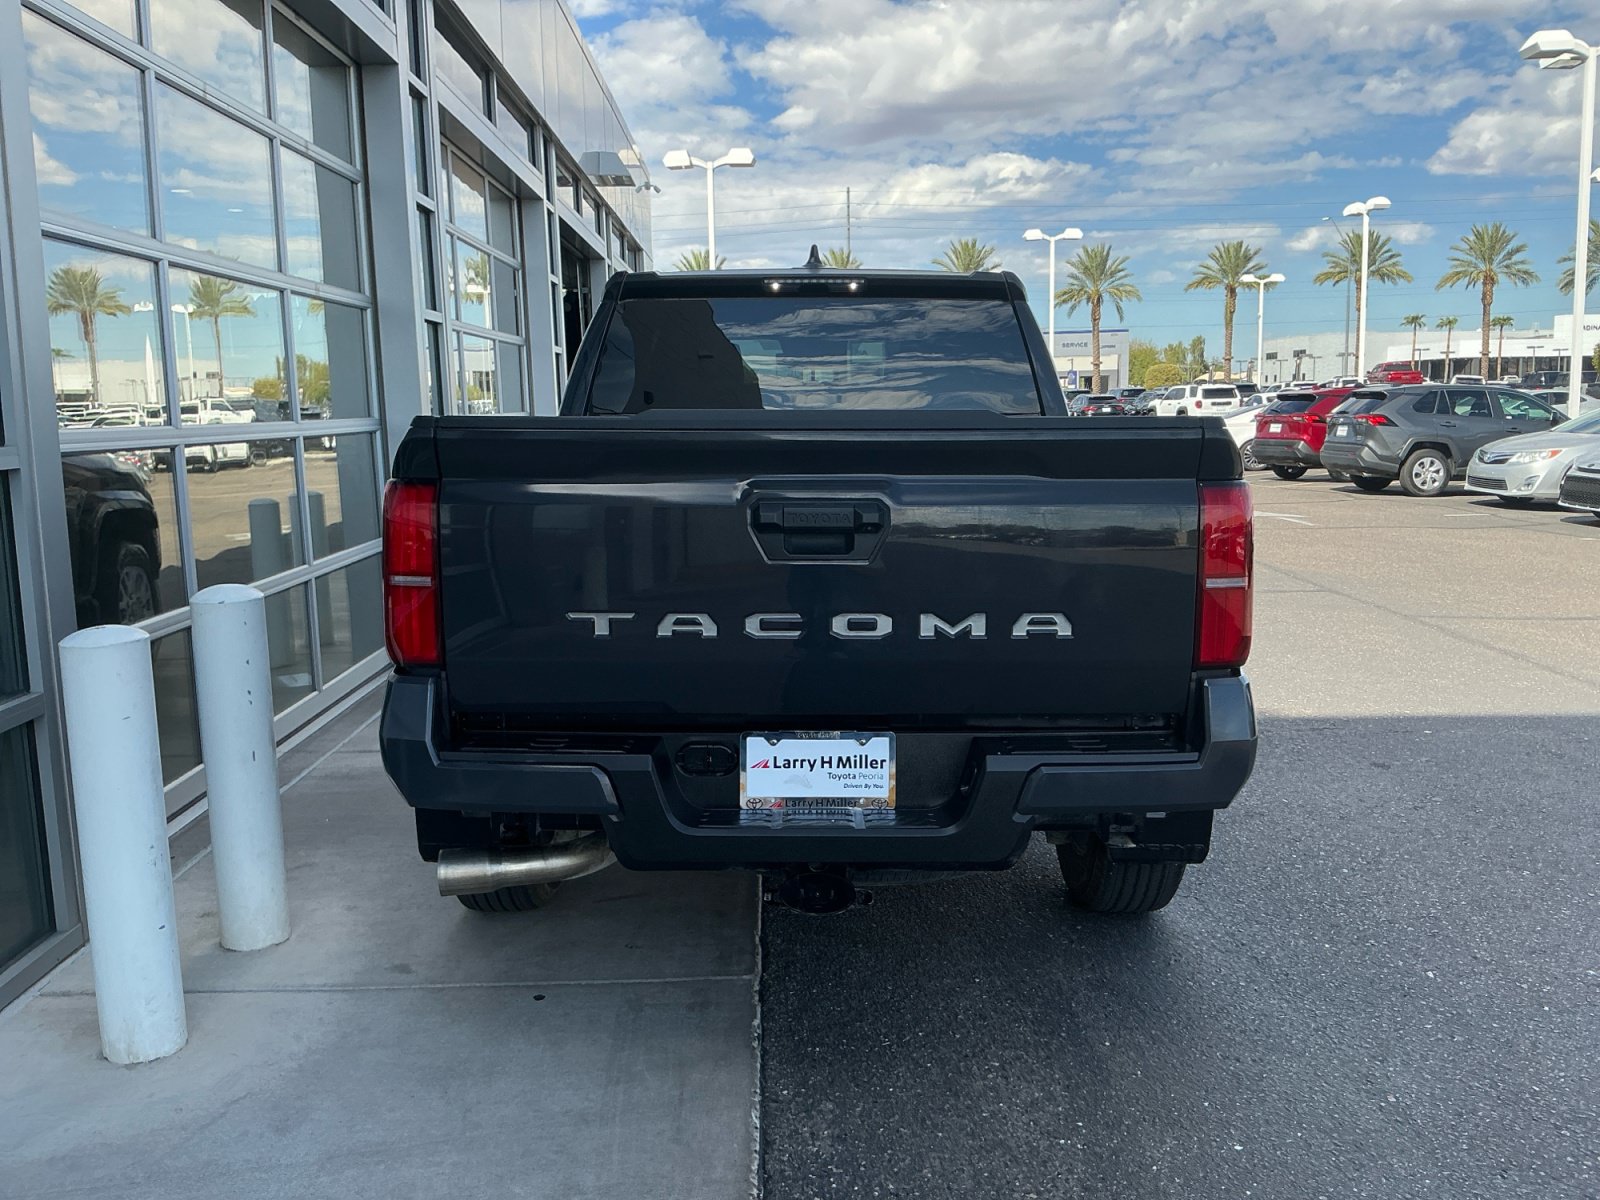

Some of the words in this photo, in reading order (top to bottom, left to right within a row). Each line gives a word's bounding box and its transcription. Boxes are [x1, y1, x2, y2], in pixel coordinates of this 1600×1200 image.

[789, 512, 851, 525] TOYOTA
[566, 612, 1075, 640] TACOMA
[773, 756, 817, 772] Larry
[821, 756, 832, 769] H
[836, 754, 887, 769] Miller
[827, 772, 856, 781] Toyota
[858, 772, 884, 780] Peoria
[785, 799, 812, 808] Larry
[815, 799, 824, 807] H
[826, 798, 858, 808] Miller
